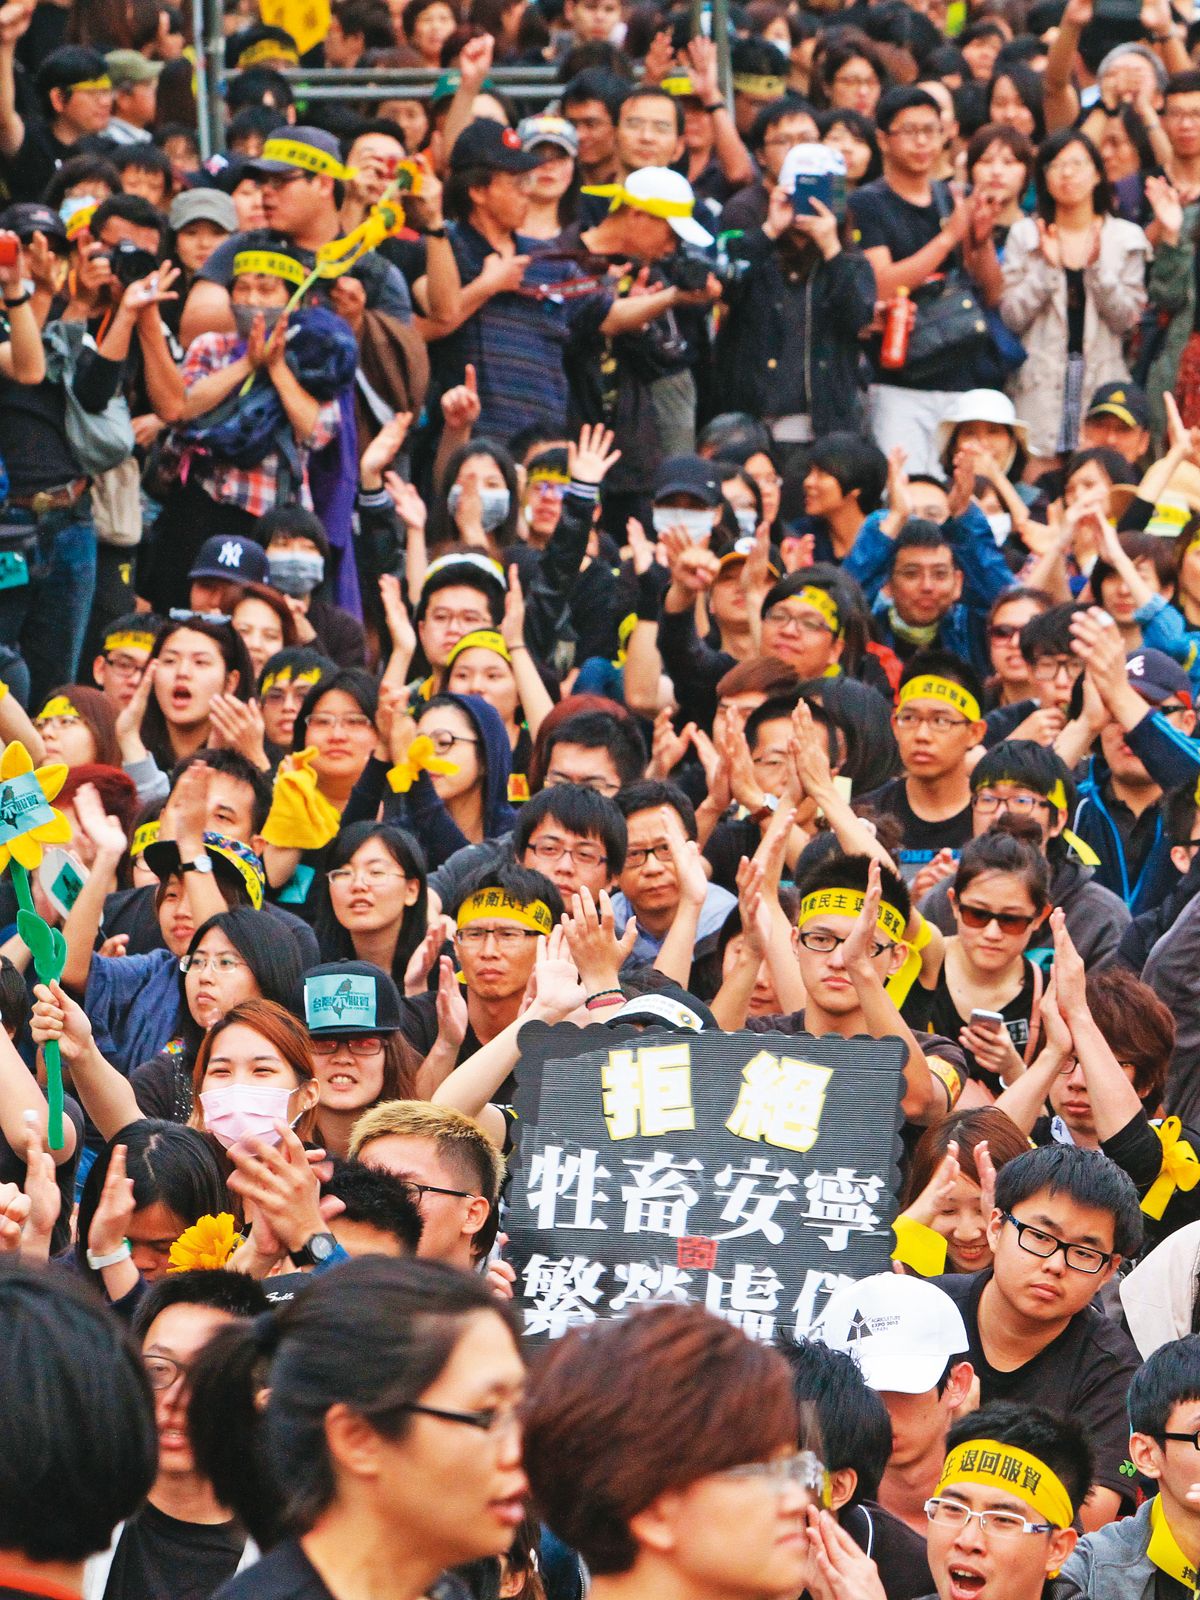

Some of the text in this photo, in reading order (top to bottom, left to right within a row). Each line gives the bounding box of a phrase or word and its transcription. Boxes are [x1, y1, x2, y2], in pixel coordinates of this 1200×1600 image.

[526, 1144, 886, 1252] 牲畜安寧
[958, 1450, 1041, 1496] 退回服貿
